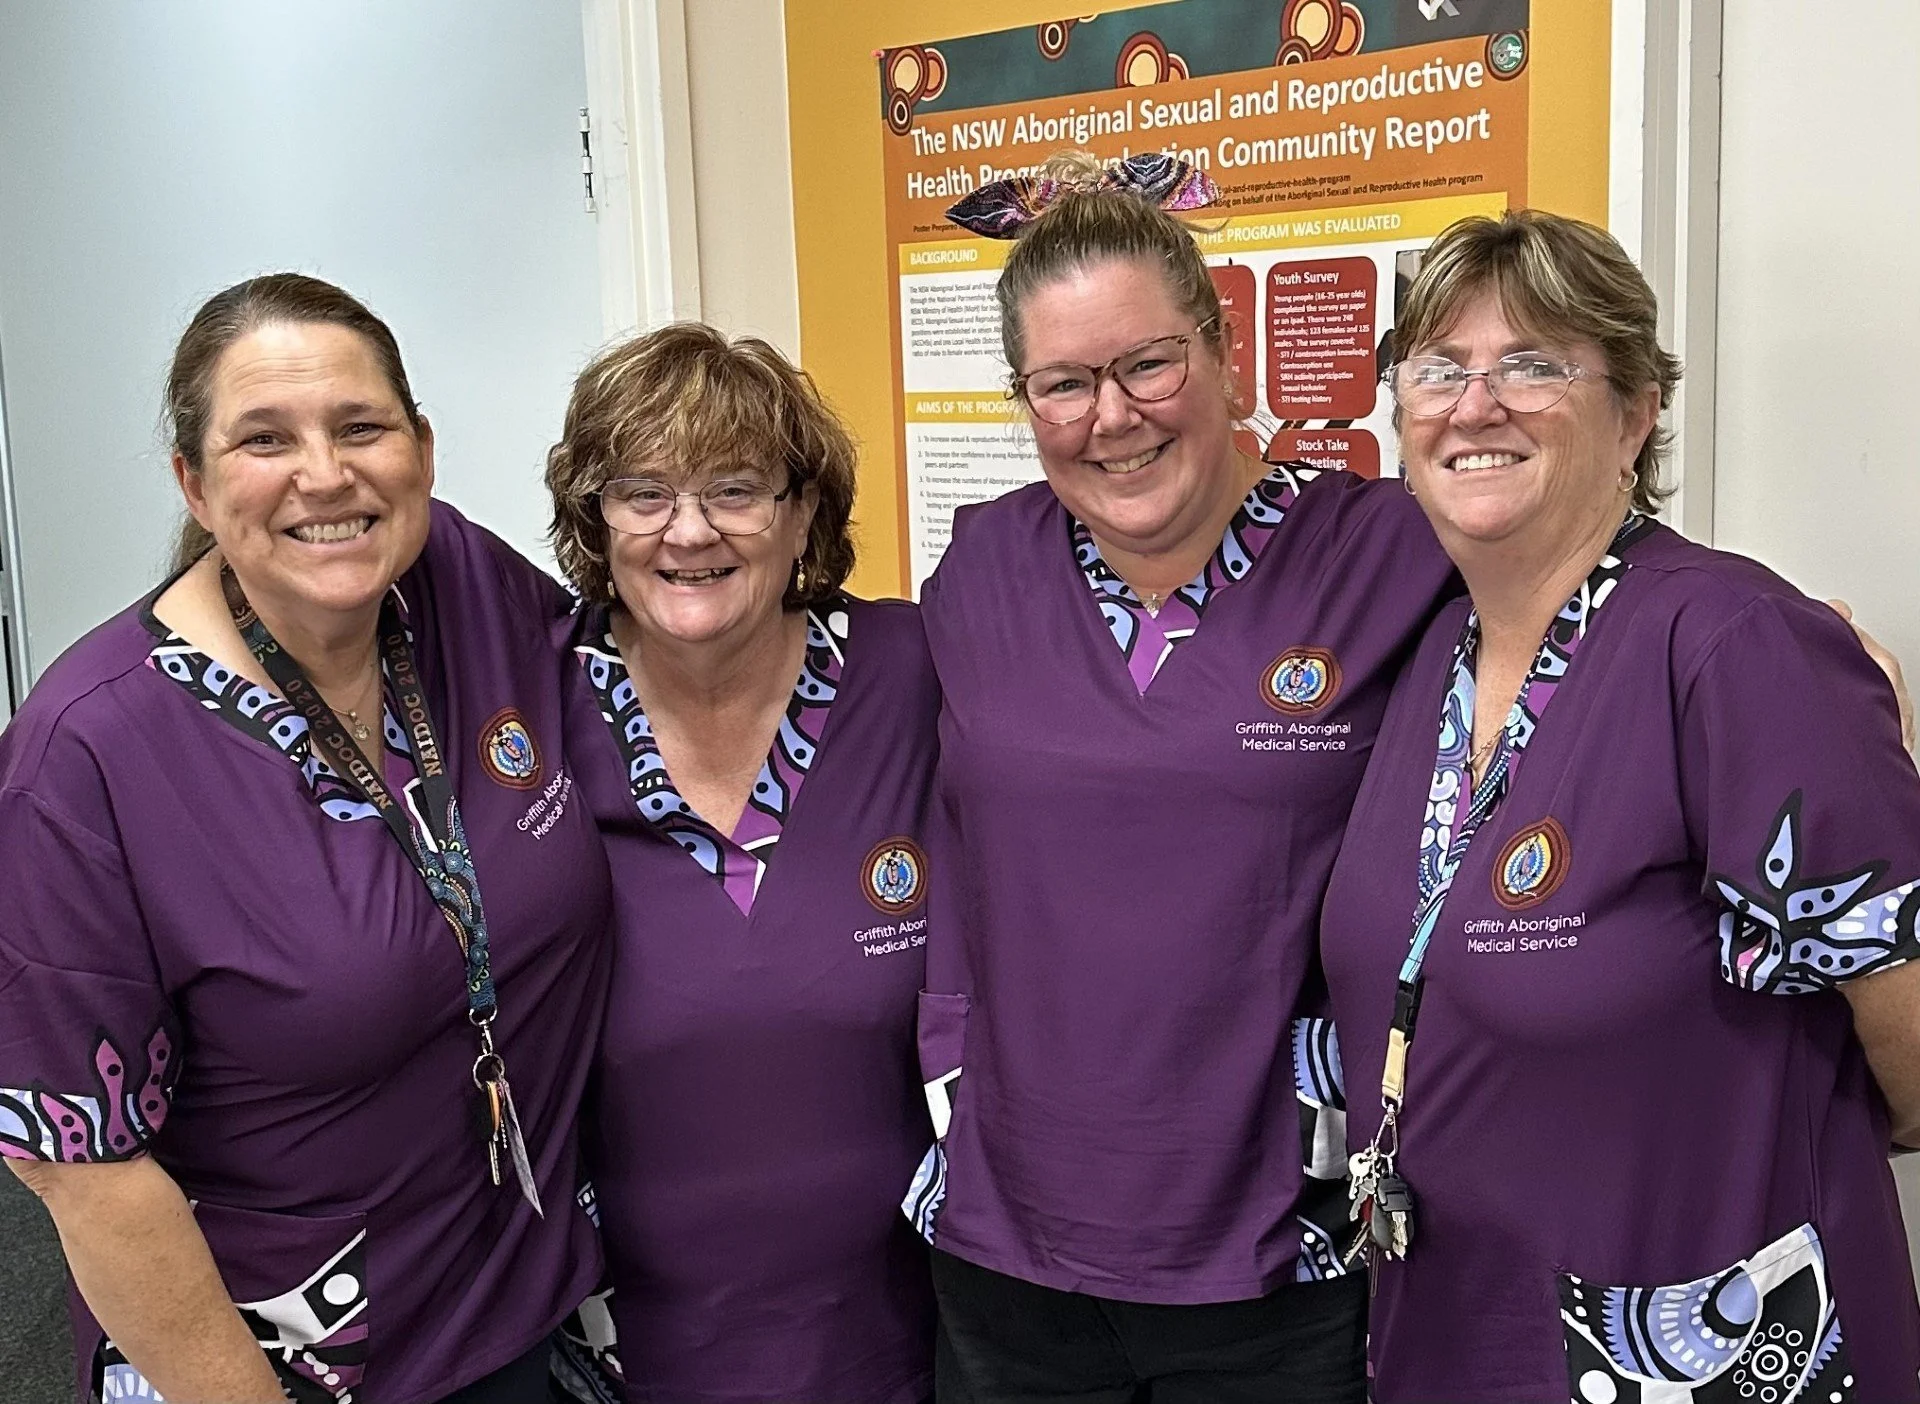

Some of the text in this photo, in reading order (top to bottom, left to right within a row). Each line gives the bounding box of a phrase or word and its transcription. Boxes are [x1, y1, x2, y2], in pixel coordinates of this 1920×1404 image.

[910, 126, 946, 157] The
[952, 117, 1007, 152] NSW
[1011, 99, 1133, 146] Aboriginal
[1139, 87, 1222, 130] Sexual
[1229, 79, 1279, 119] and
[1288, 56, 1484, 115] Reproductive
[907, 164, 974, 199] Health
[1217, 121, 1377, 169] Community
[1384, 107, 1491, 154] Report
[1242, 194, 1264, 205] behalf
[1265, 193, 1274, 203] of
[1274, 191, 1286, 202] the
[1287, 187, 1326, 201] Aboriginal
[1326, 186, 1351, 198] Sexual
[1352, 182, 1368, 195] and
[1369, 178, 1421, 194] Reproductive
[1422, 175, 1447, 188] Health
[1448, 173, 1484, 187] program
[1226, 224, 1290, 243] PROGRAM
[1292, 220, 1322, 237] WAS
[1324, 213, 1402, 234] EVALUATED
[909, 248, 978, 265] BACKGROUND
[1273, 271, 1340, 286] Youth Survey
[1273, 295, 1292, 303] Young
[1293, 293, 1314, 303] people
[1336, 292, 1350, 300] year
[1273, 302, 1367, 315] completed the survey on paper
[1307, 315, 1325, 324] There
[1326, 315, 1342, 323] were
[1321, 325, 1345, 336] females
[1346, 325, 1358, 334] and
[1296, 338, 1308, 347] The
[1309, 338, 1330, 348] survey
[1294, 349, 1337, 360] contraception
[1336, 347, 1370, 358] knowledge
[1280, 361, 1334, 372] Contraception use
[1294, 371, 1316, 381] activity
[1316, 371, 1354, 381] participation
[1280, 384, 1300, 392] Sexual
[1291, 394, 1311, 404] testing
[1311, 394, 1333, 404] history
[915, 401, 941, 414] AIMS
[942, 400, 956, 414] OF
[957, 400, 975, 413] THE
[1296, 438, 1350, 452] Stock Take
[1235, 721, 1351, 736] Griffith Aboriginal
[1242, 738, 1346, 751] Medical Service
[516, 798, 549, 831] Griffith
[531, 800, 564, 841] Medical
[853, 916, 927, 942] Griffith Abori
[1464, 911, 1586, 934] Griffith Aboriginal
[863, 934, 927, 957] Medical Ser
[1467, 935, 1578, 953] Medical Service
